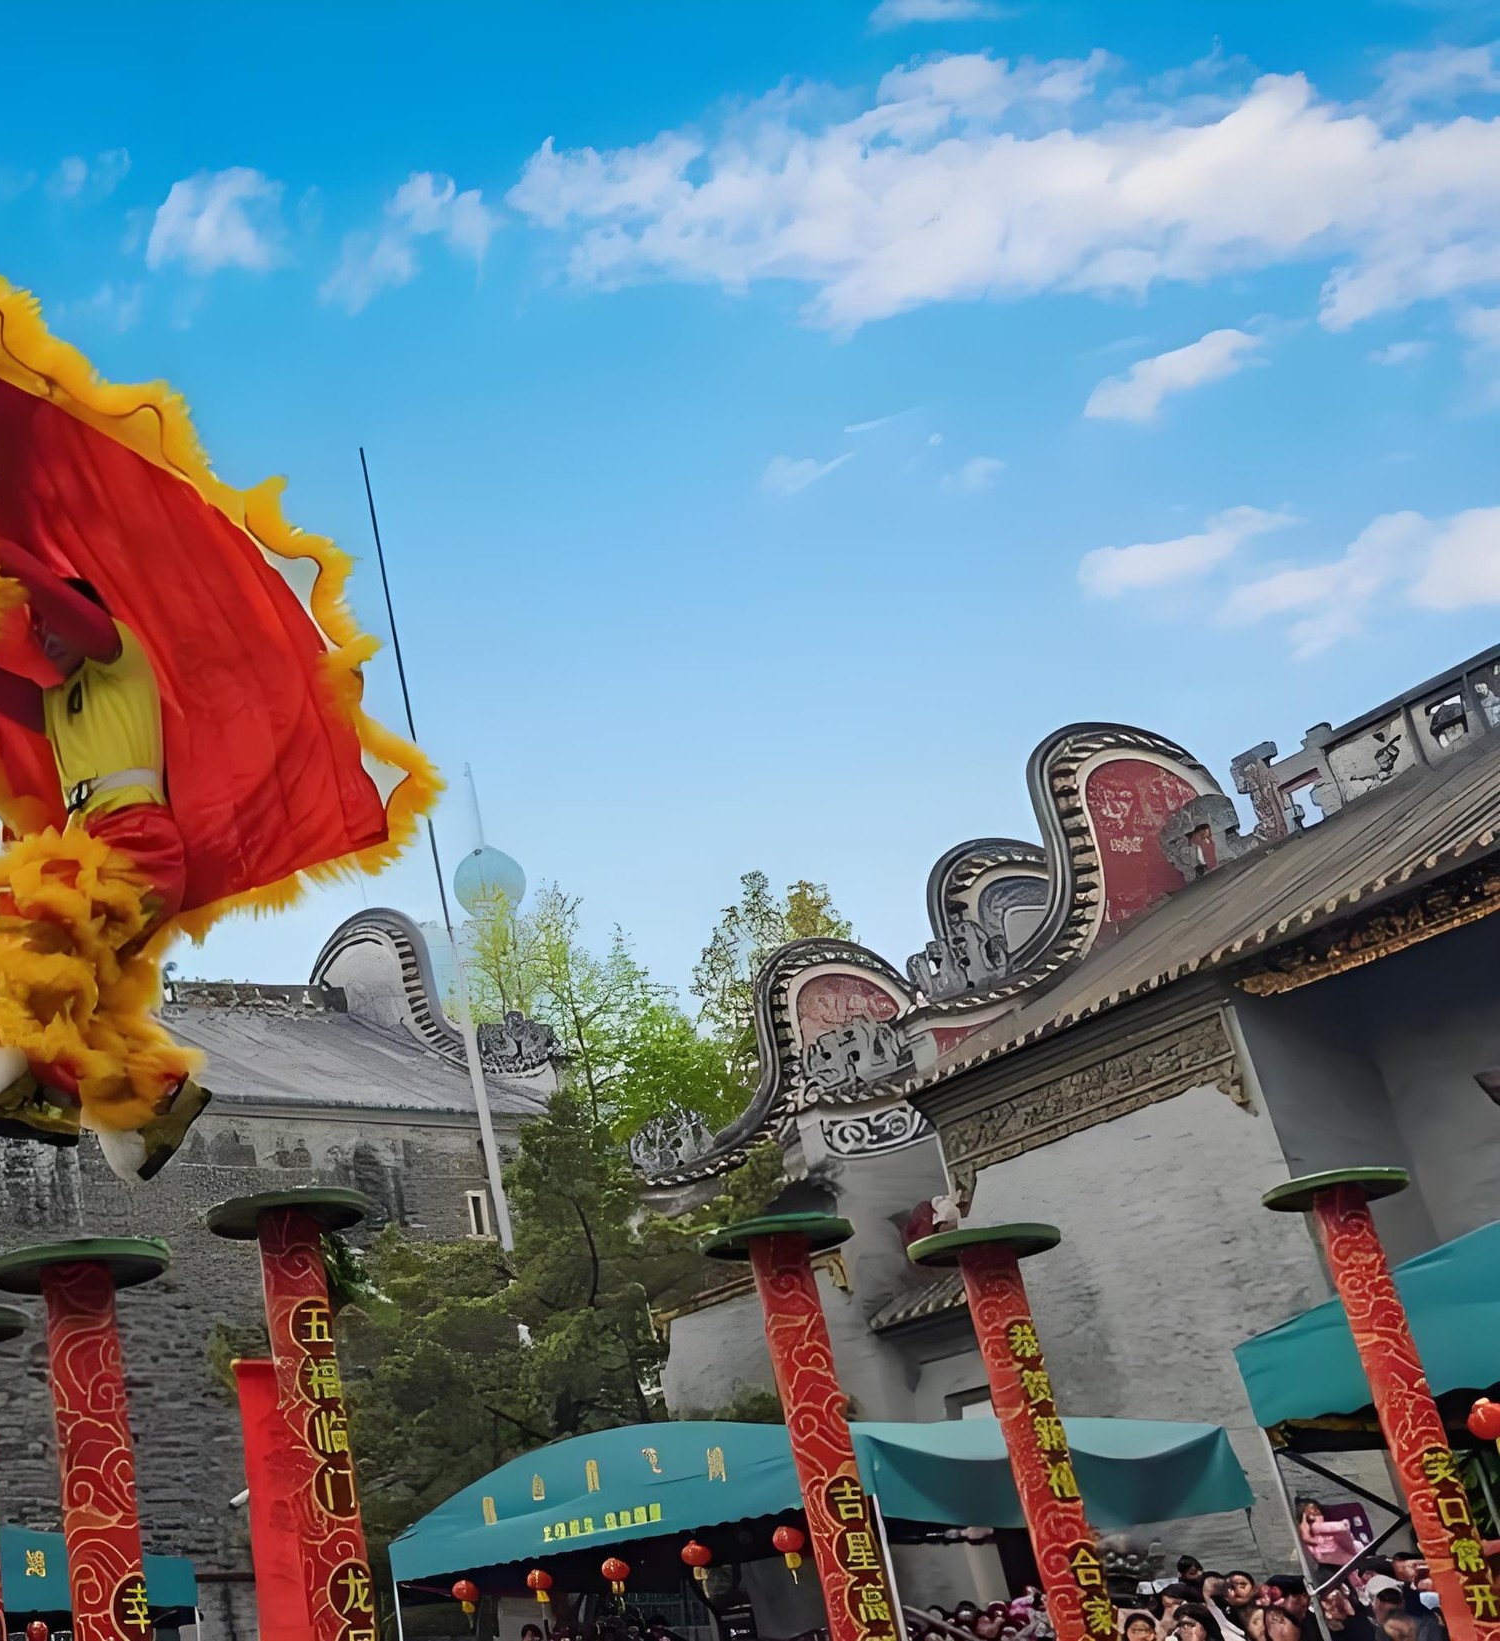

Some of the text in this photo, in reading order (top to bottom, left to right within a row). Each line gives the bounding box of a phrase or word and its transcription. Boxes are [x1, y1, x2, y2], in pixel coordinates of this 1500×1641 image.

[337, 1568, 376, 1641] 龙
[829, 1480, 896, 1641] 吉星高
[1422, 1452, 1499, 1619] 笑口常开
